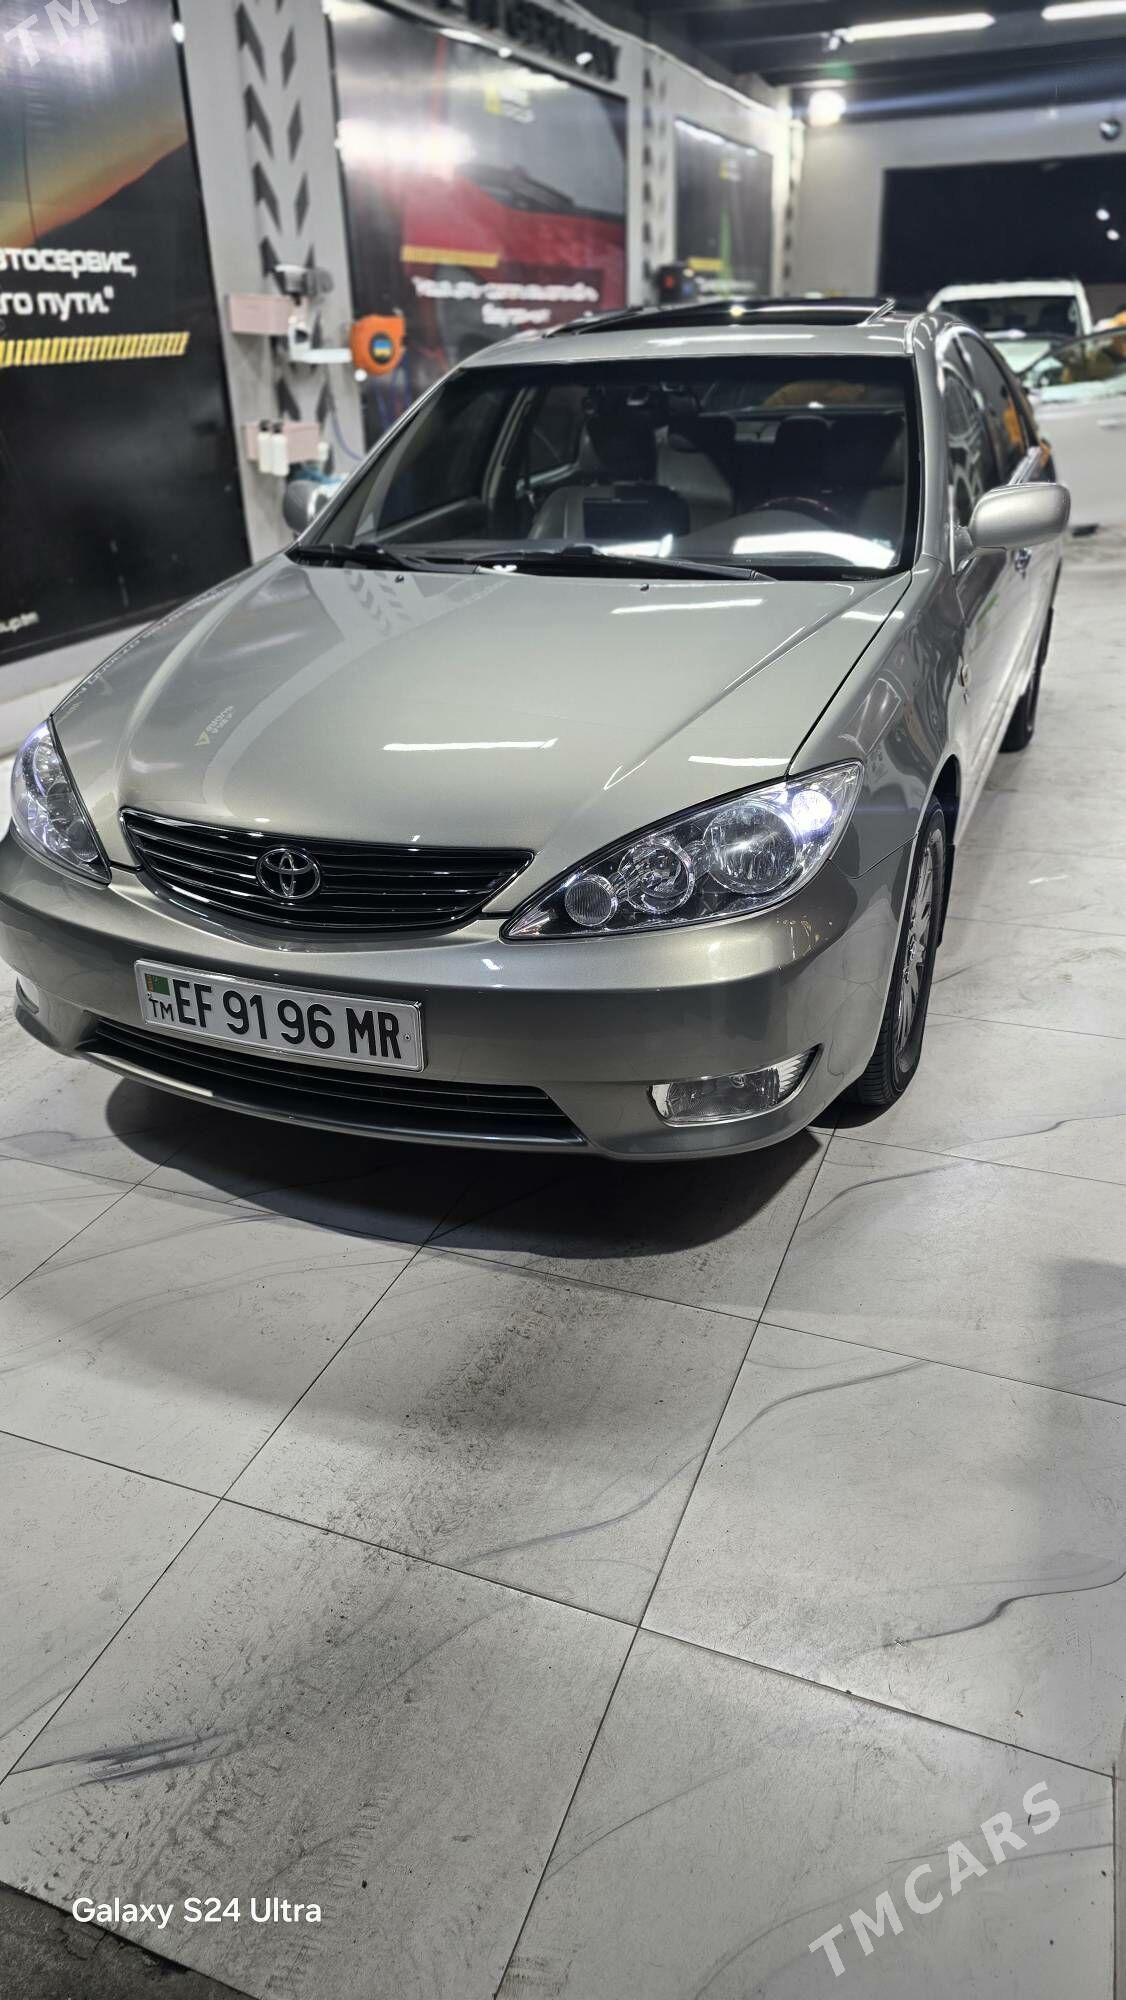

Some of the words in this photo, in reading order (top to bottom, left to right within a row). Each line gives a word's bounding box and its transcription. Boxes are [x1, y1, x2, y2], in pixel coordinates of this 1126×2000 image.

[0, 292, 33, 315] го
[149, 998, 175, 1022] TM
[172, 978, 212, 1028] EF
[345, 1007, 402, 1059] MR
